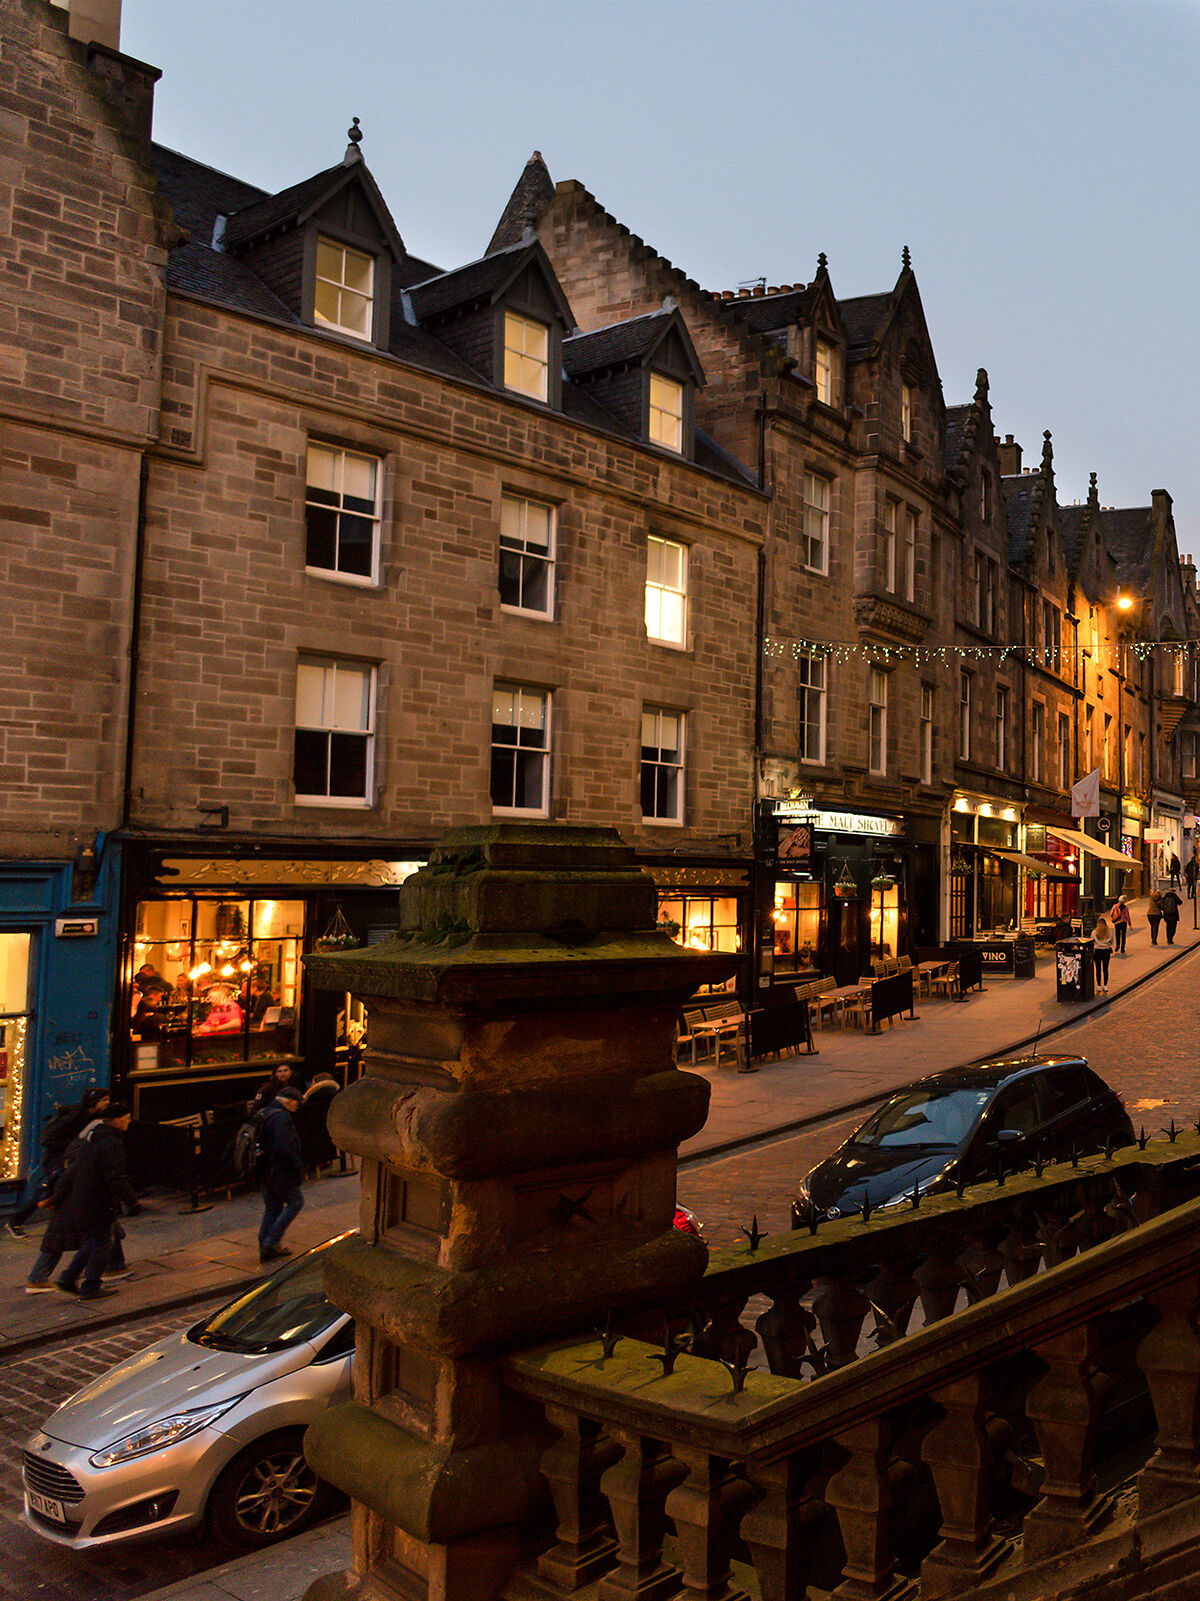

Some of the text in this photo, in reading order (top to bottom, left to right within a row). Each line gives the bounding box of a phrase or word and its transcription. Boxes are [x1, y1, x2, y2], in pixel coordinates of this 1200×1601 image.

[830, 814, 855, 829] MALT
[857, 818, 889, 833] SHOVEL
[982, 952, 1007, 961] VINO
